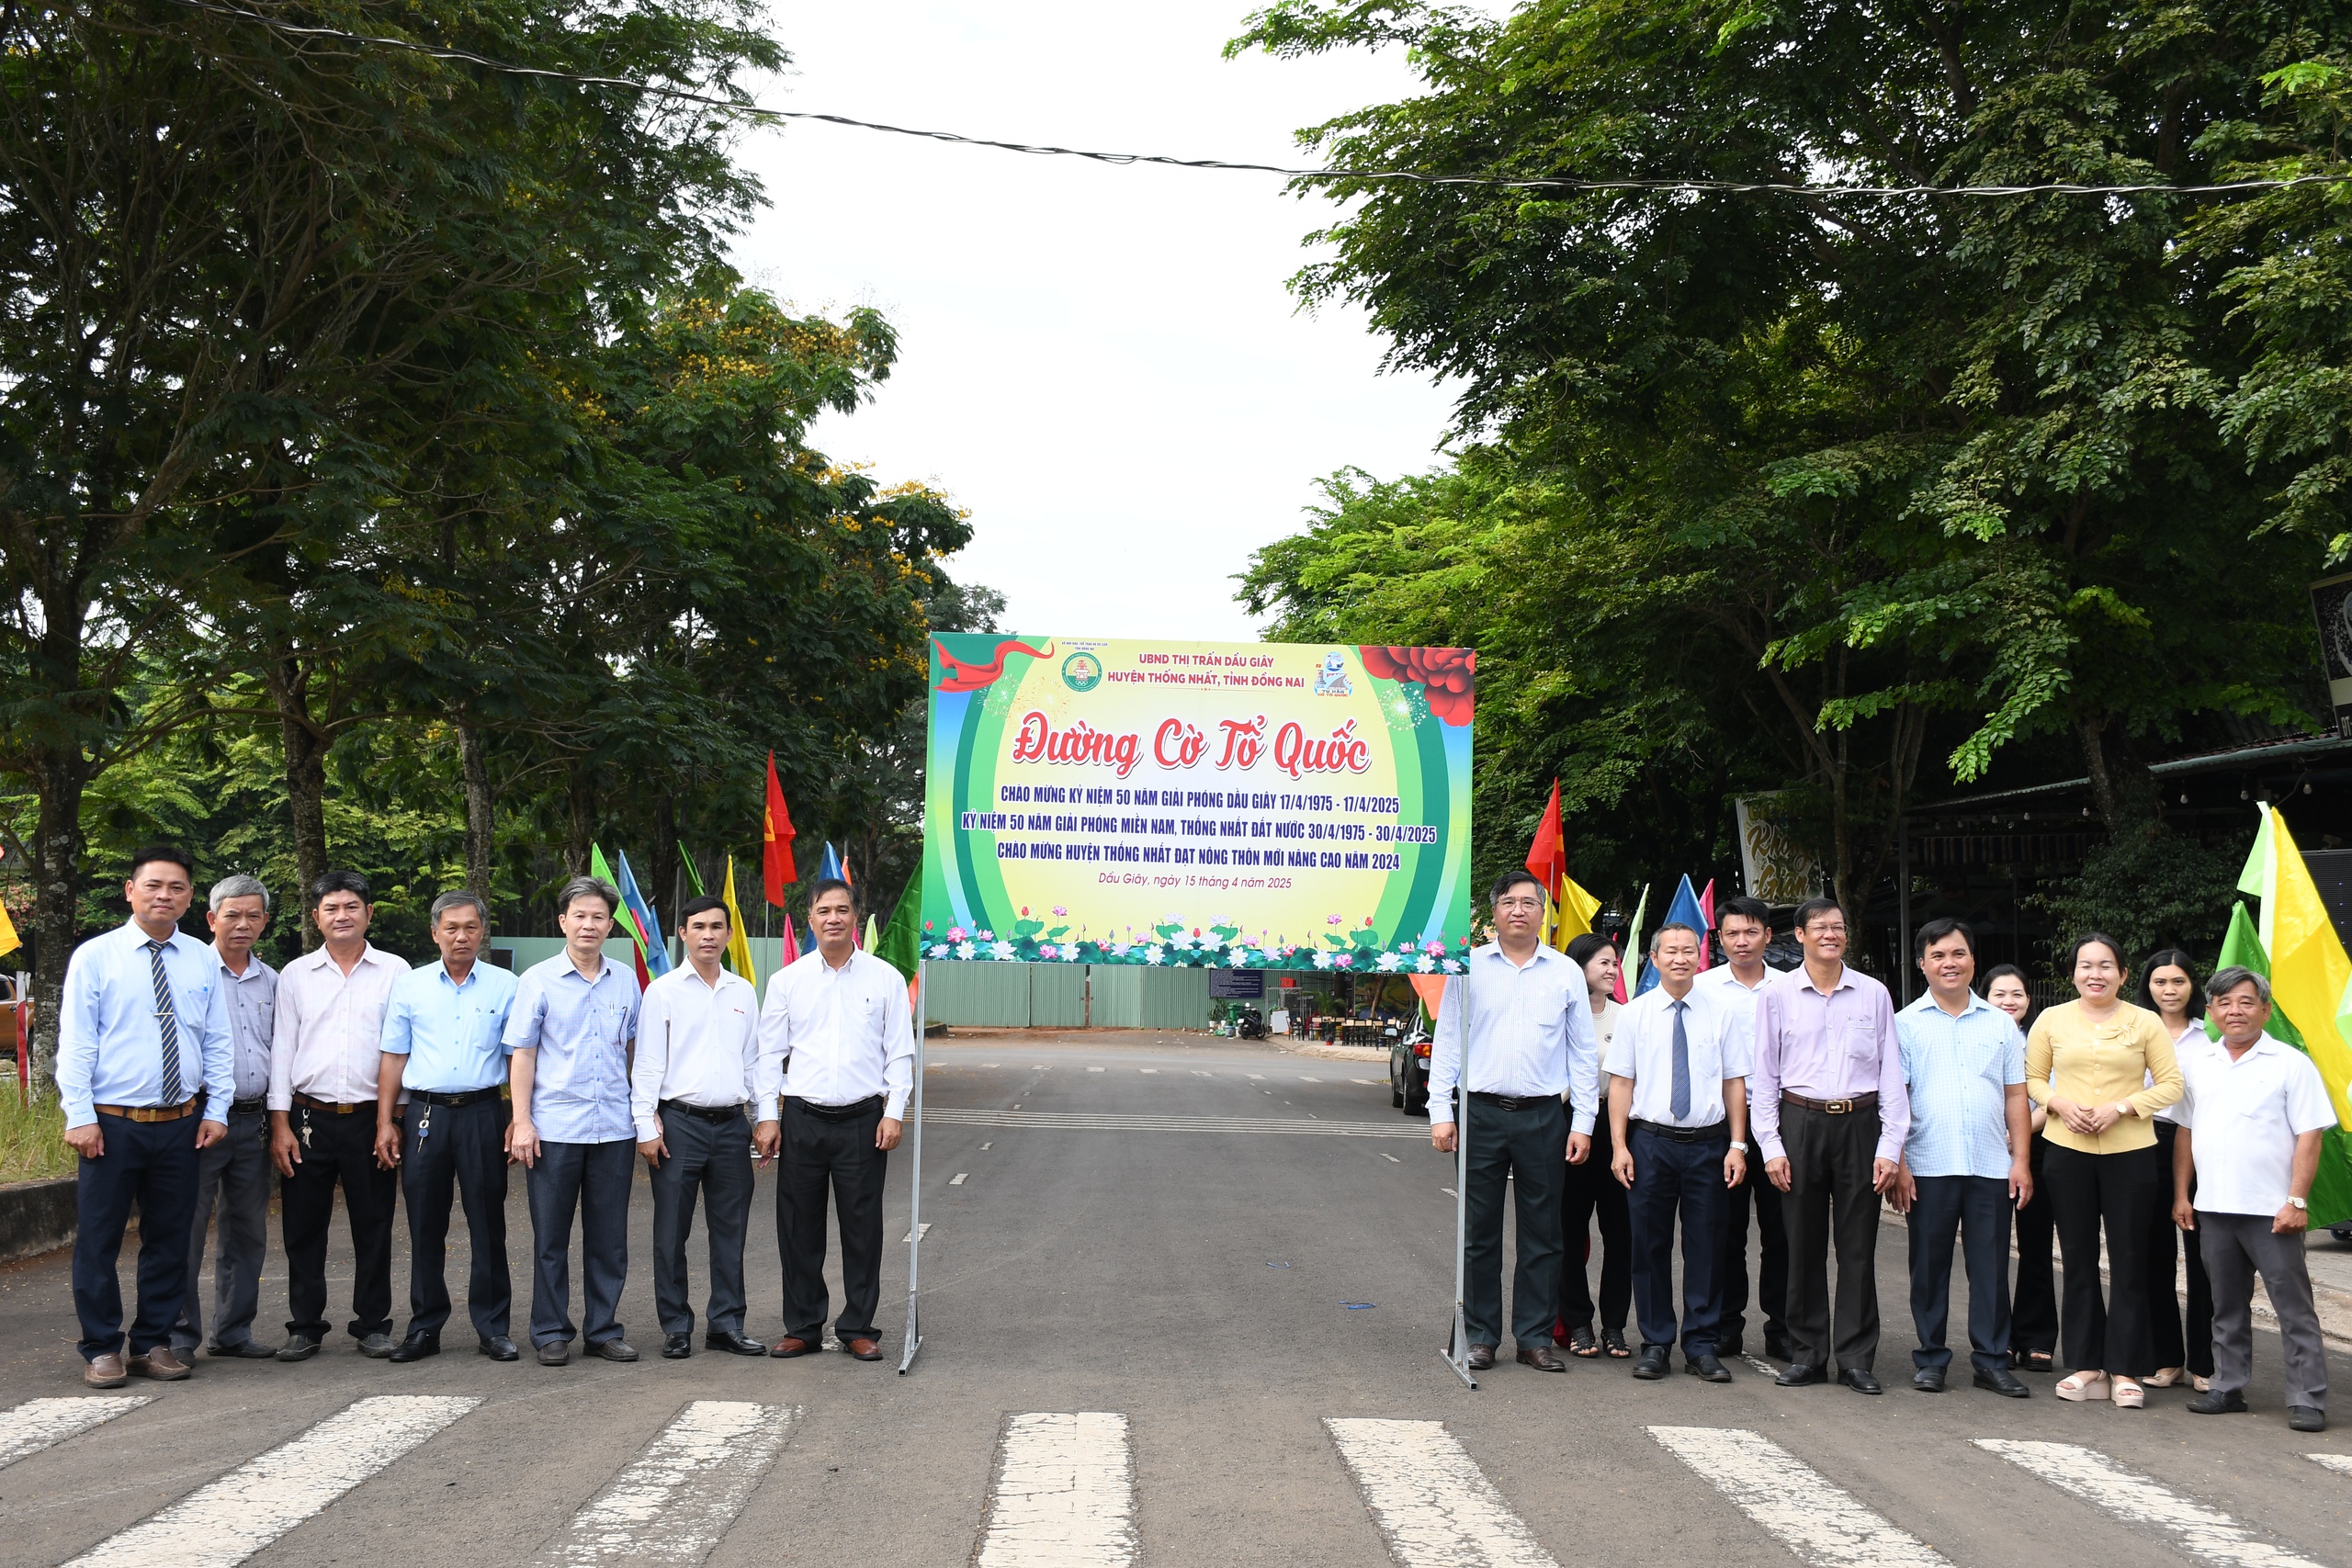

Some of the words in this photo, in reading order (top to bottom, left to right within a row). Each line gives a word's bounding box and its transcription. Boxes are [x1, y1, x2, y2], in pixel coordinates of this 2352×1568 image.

[1139, 654, 1169, 664] UBND
[1172, 655, 1190, 667] THỊ
[1193, 652, 1222, 665] TRẤN
[1225, 652, 1247, 667] DẦU
[1250, 656, 1273, 667] GIÂY
[1108, 669, 1145, 684] HUYỆN
[1148, 670, 1186, 684] THỐNG
[1189, 671, 1221, 687] NHẤT,
[1224, 672, 1248, 685] TỈNH
[1251, 672, 1283, 687] ĐỒNG
[1285, 677, 1304, 687] NAI
[1013, 712, 1141, 775] Đường
[1154, 718, 1207, 766] Cờ
[1216, 715, 1265, 767] Tổ
[1274, 719, 1369, 777] Quốc
[1001, 784, 1031, 802] CHÀO
[1034, 785, 1065, 803] MỪNG
[1069, 784, 1082, 803] KỶ
[1087, 786, 1113, 807] NIỆM
[1116, 789, 1130, 805] 50
[1135, 787, 1158, 806] NĂM
[1162, 786, 1183, 807] GIẢI
[1187, 790, 1224, 808] PHÓNG
[1227, 788, 1248, 808] DẦU
[1252, 791, 1276, 809] GIÂY
[1280, 795, 1332, 811] 17/4/1975
[1344, 796, 1398, 813] 17/4/2025
[963, 809, 977, 829] KỶ
[980, 811, 1007, 832] NIỆM
[1011, 815, 1023, 830] 50
[1028, 813, 1051, 830] NĂM
[1056, 813, 1077, 831] GIẢI
[1081, 815, 1117, 833] PHÓNG
[1121, 813, 1147, 833] MIỀN
[1151, 818, 1177, 836] NAM,
[1181, 816, 1216, 836] THỐNG
[1220, 817, 1248, 837] NHẤT
[1251, 817, 1272, 837] ĐẤT
[1275, 819, 1305, 839] NƯỚC
[1308, 823, 1364, 840] 30/4/1975
[1376, 826, 1435, 842] 30/4/2025
[998, 840, 1027, 859] CHÀO
[1031, 841, 1062, 860] MỪNG
[1066, 843, 1100, 863] HUYỆN
[1103, 841, 1139, 862] THỐNG
[1143, 842, 1171, 863] NHẤT
[1174, 847, 1195, 866] ĐẠT
[1199, 847, 1227, 864] NÔNG
[1232, 847, 1260, 865] THÔN
[1264, 848, 1283, 866] MỚI
[1288, 849, 1317, 867] NÂNG
[1320, 852, 1340, 868] CAO
[1345, 851, 1368, 869] NĂM
[1373, 853, 1399, 870] 2024
[1099, 871, 1120, 884] Dầu
[1123, 873, 1150, 887] Giây,
[1154, 874, 1182, 888] ngày
[1185, 875, 1196, 886] 15
[1199, 877, 1229, 889] tháng
[1232, 878, 1238, 886] 4
[1241, 877, 1265, 887] năm
[1268, 878, 1291, 888] 2025
